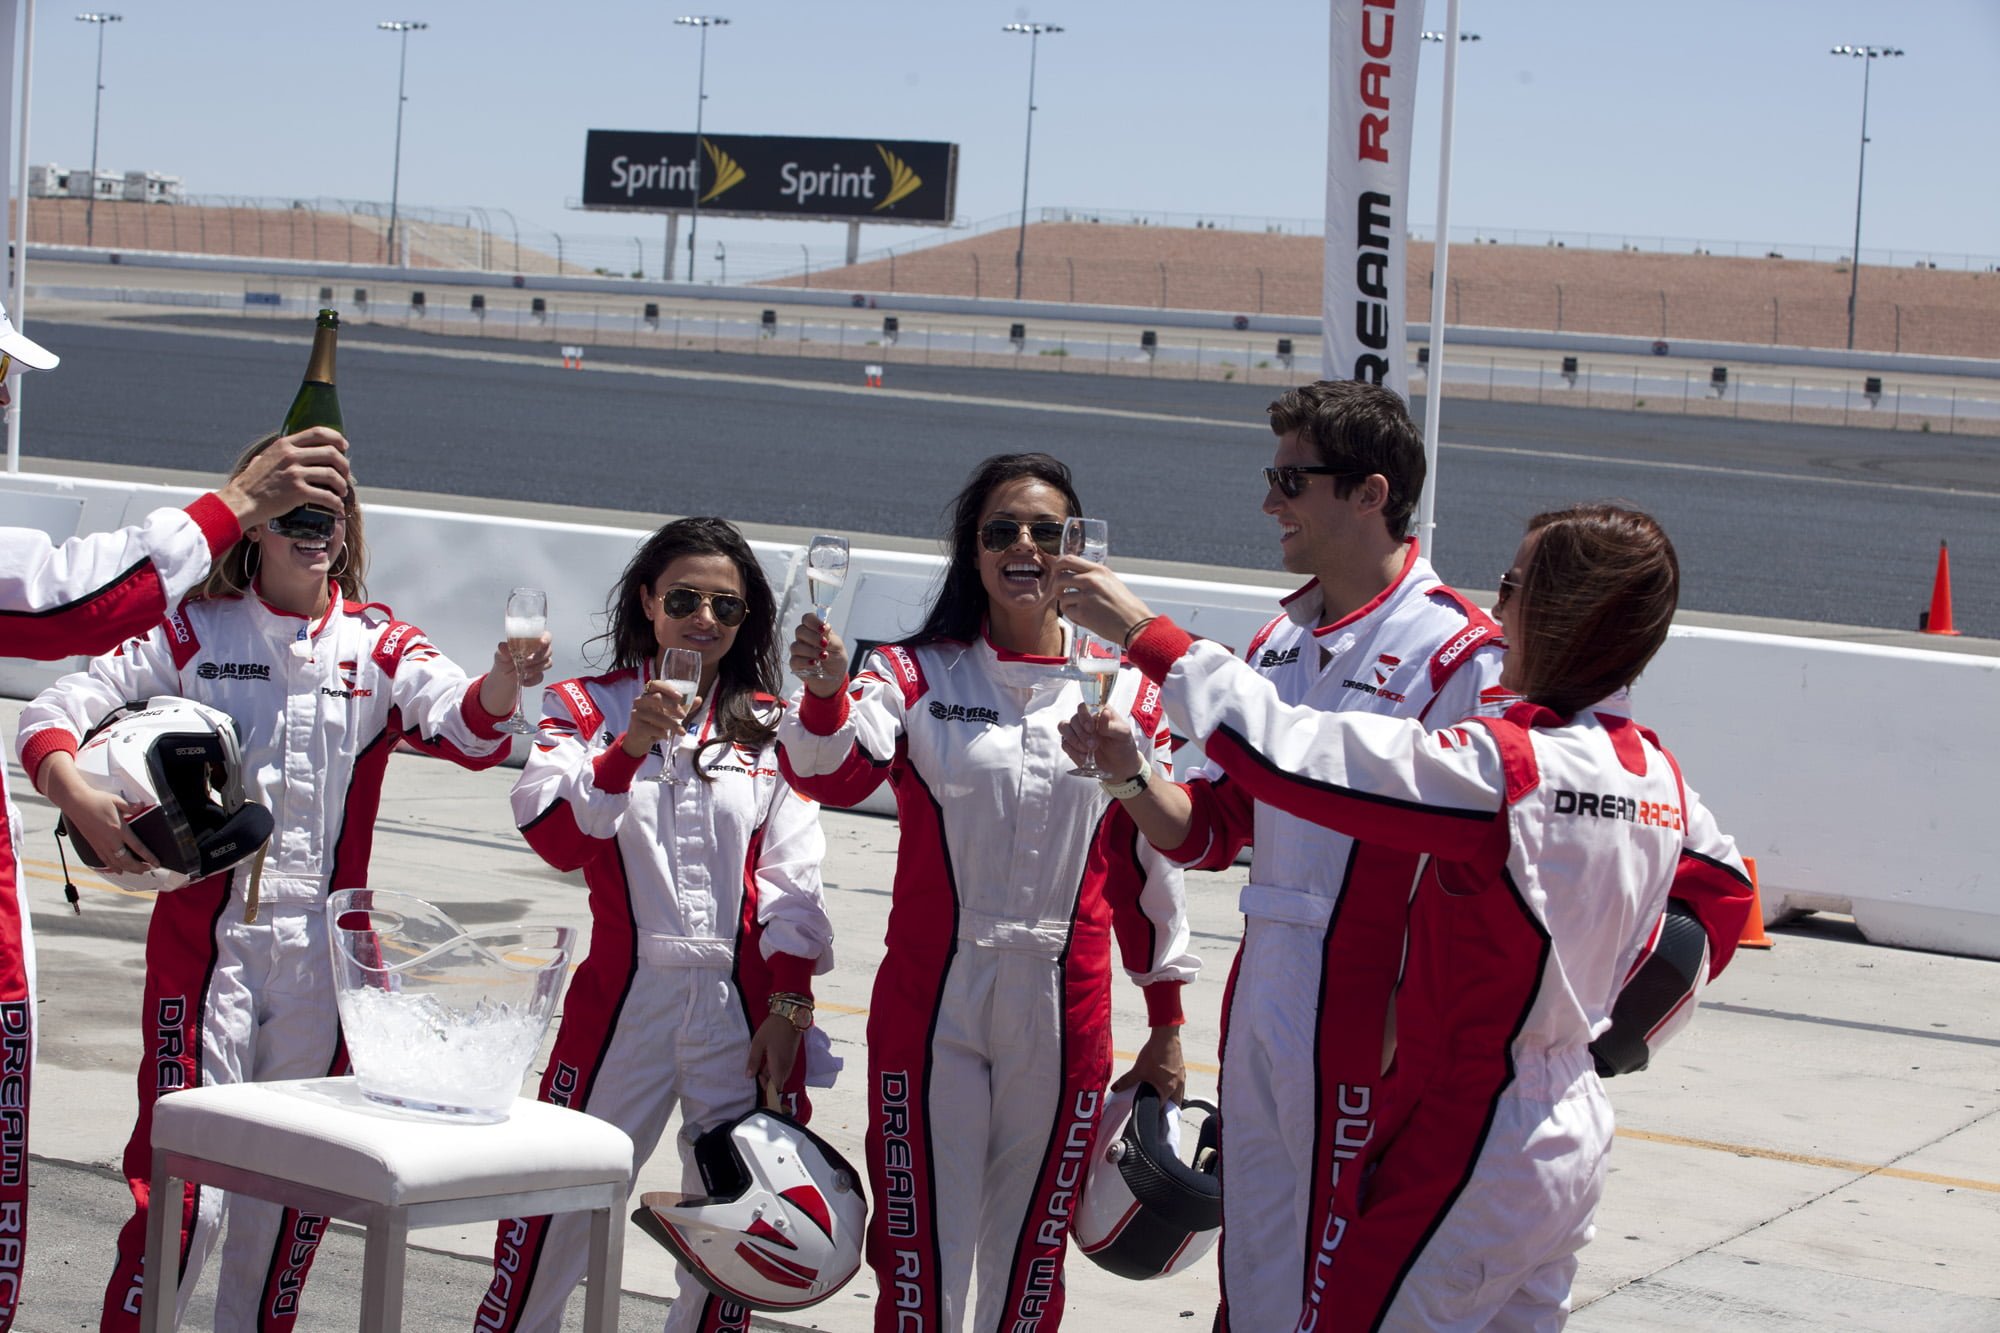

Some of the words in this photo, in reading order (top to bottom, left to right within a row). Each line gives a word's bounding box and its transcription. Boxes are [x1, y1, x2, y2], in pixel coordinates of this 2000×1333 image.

[611, 155, 700, 198] Sprint
[780, 162, 876, 205] Sprint
[1354, 190, 1391, 387] REAM
[171, 611, 190, 644] arco
[1439, 626, 1489, 667] sparco
[220, 662, 237, 675] LAS
[238, 663, 271, 677] VEGAS
[890, 645, 918, 683] sparco
[562, 682, 593, 717] sparco
[1141, 680, 1161, 715] spar
[1341, 679, 1378, 696] DREAM
[947, 704, 966, 717] LAS
[966, 706, 1000, 722] VEGAS
[708, 764, 746, 775] DREAM
[1638, 800, 1681, 831] RACG
[156, 994, 187, 1100] DRE
[0, 998, 29, 1186] DREAM
[881, 1070, 918, 1239] DREAM
[1037, 1090, 1099, 1246] RACING
[271, 1210, 324, 1319] DREA
[475, 1217, 528, 1333] RACIN
